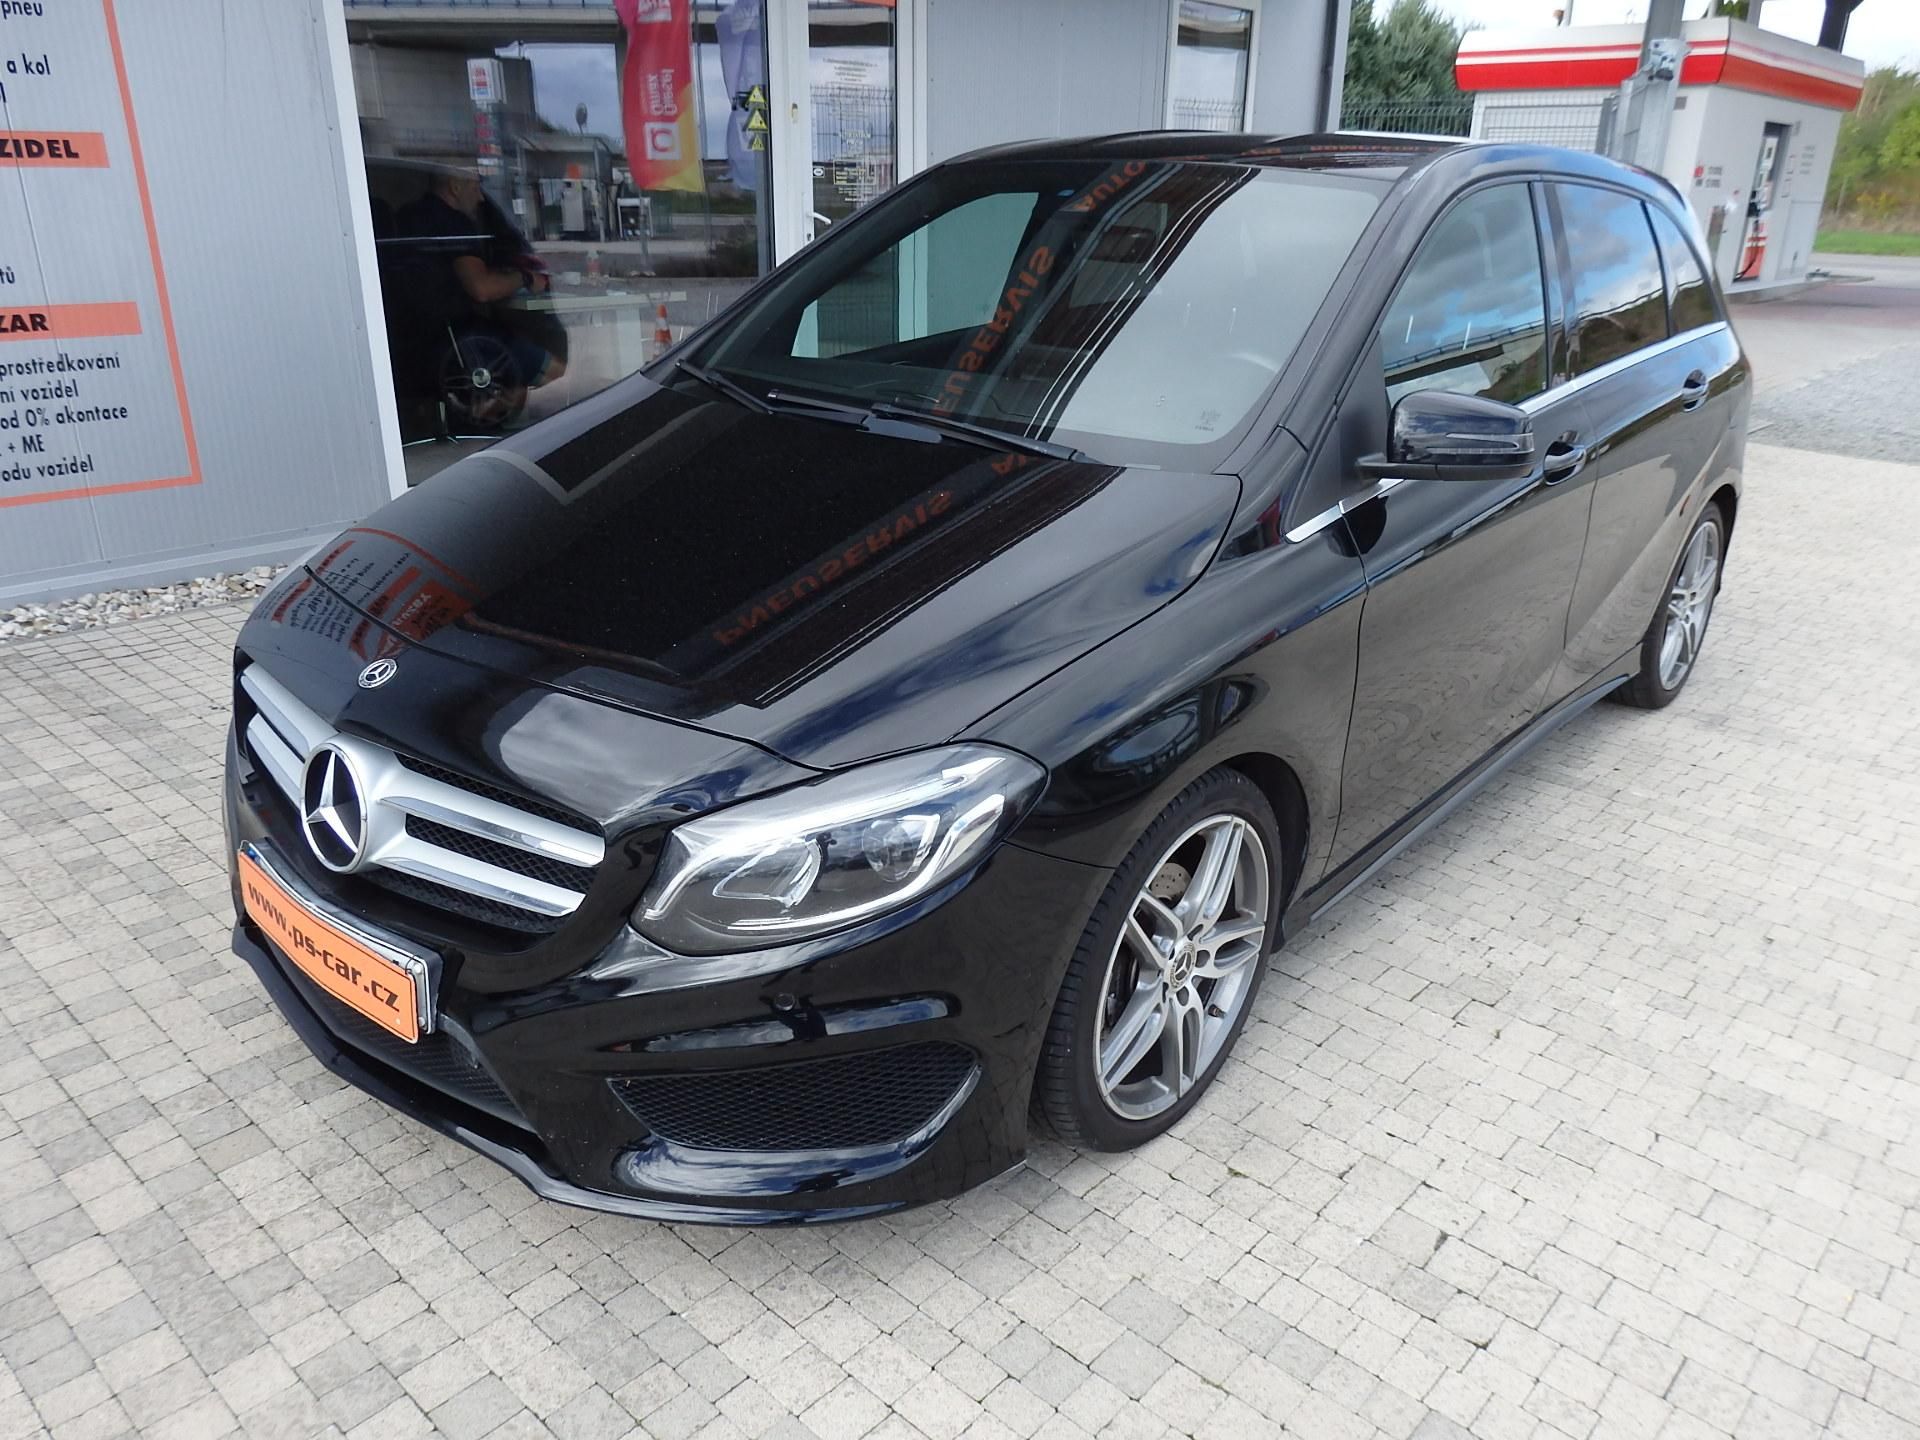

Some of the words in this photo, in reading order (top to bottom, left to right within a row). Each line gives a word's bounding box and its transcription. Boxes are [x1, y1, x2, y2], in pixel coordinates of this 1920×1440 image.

[1, 0, 43, 19] pneu
[7, 60, 17, 74] a
[22, 53, 51, 75] kol
[0, 138, 80, 158] ZIDEL
[0, 352, 120, 381] prostředkování
[21, 379, 79, 401] vozidel
[1, 412, 20, 430] od
[25, 407, 50, 427] 0%
[56, 405, 128, 424] akontace
[22, 434, 45, 454] ME
[2, 462, 31, 482] odu
[37, 454, 94, 478] vozidel
[248, 882, 400, 1013] www.ps-car.cz
